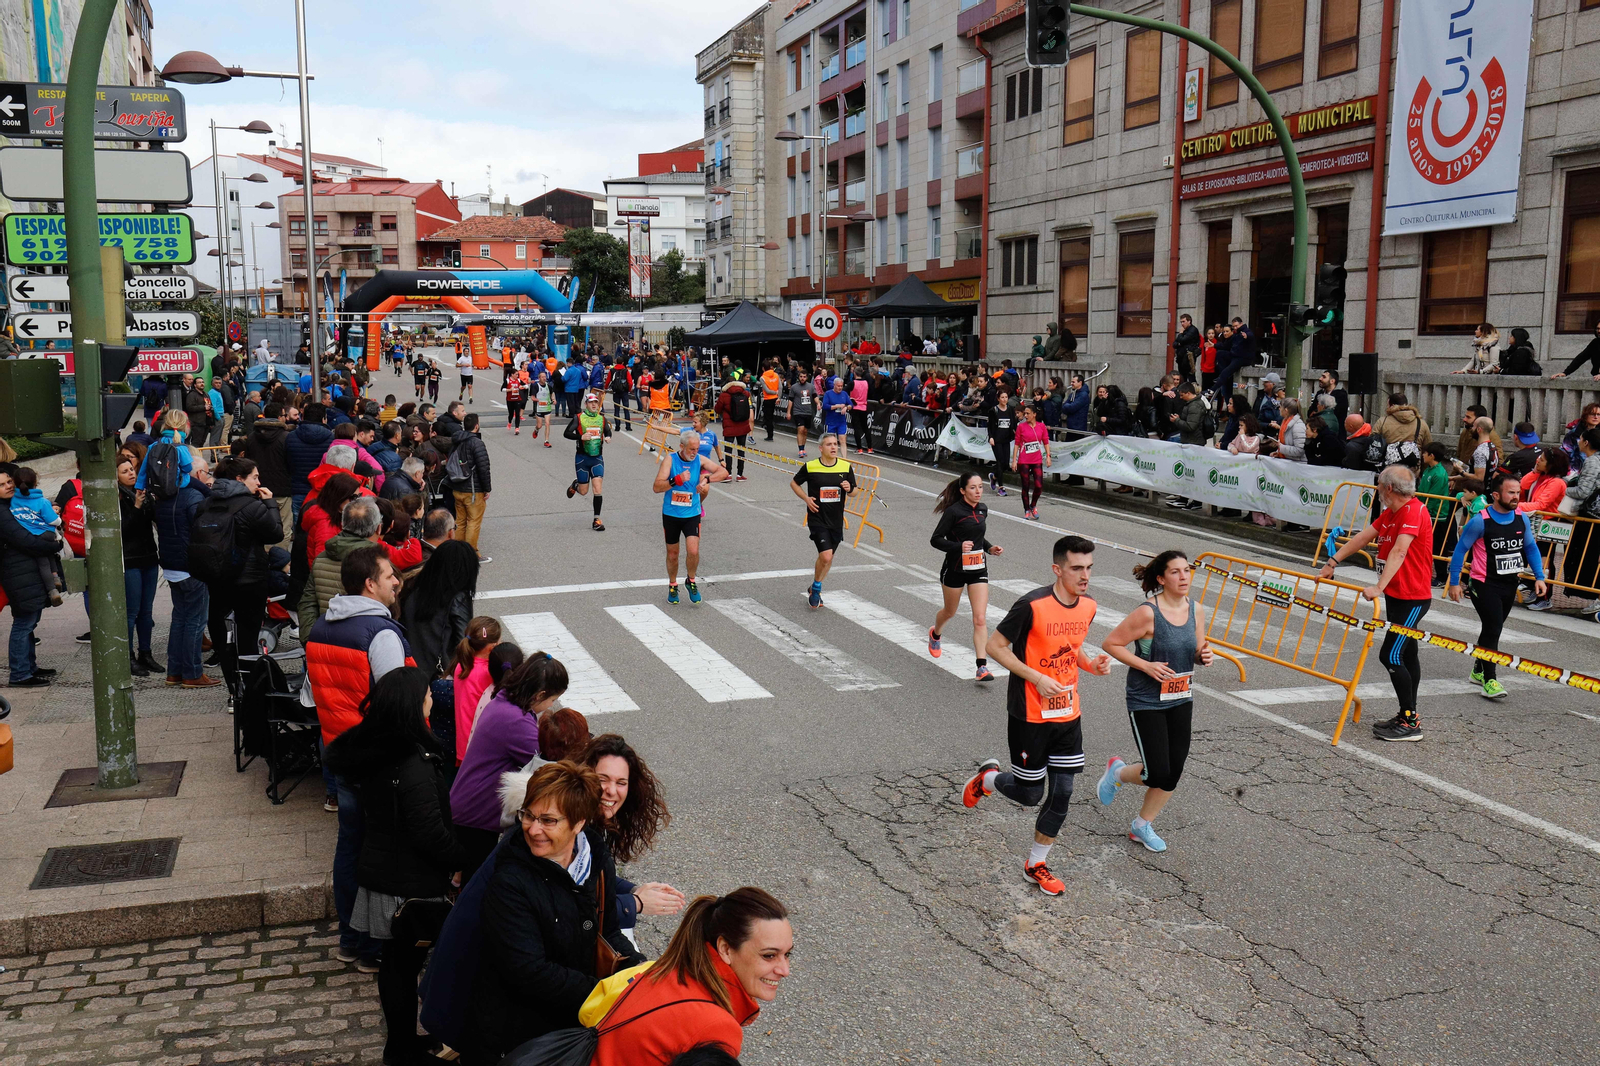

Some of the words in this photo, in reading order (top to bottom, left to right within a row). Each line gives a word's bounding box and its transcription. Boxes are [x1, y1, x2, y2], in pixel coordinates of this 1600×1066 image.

[130, 92, 170, 103] TAPERIA
[1410, 104, 1423, 128] 25
[2, 119, 21, 127] 500M
[1181, 134, 1222, 159] CENTRO
[1298, 100, 1370, 134] MUNICIPAL
[1445, 85, 1504, 181] 1993-2018
[1410, 137, 1434, 177] anos
[1182, 183, 1196, 194] SALAS
[1198, 182, 1204, 191] DE
[99, 217, 181, 235] ISPONIBLE!
[22, 238, 67, 249] 619
[133, 238, 178, 248] 758
[23, 250, 67, 261] 902
[134, 249, 179, 260] 669
[127, 277, 186, 287] Concello
[417, 280, 501, 289] POWERADE
[152, 288, 187, 299] Local
[130, 319, 190, 331] Abastos
[813, 317, 835, 330] 40
[138, 350, 192, 362] arroquial
[158, 361, 193, 372] María
[1141, 460, 1156, 471] RAMA
[1218, 473, 1239, 486] RAMA
[1266, 482, 1285, 495] RAMA
[1310, 492, 1333, 505] RAMA
[1551, 526, 1570, 536] RAMA
[1501, 559, 1518, 570] 1702
[1168, 680, 1185, 693] 862
[1048, 695, 1067, 710] 863
